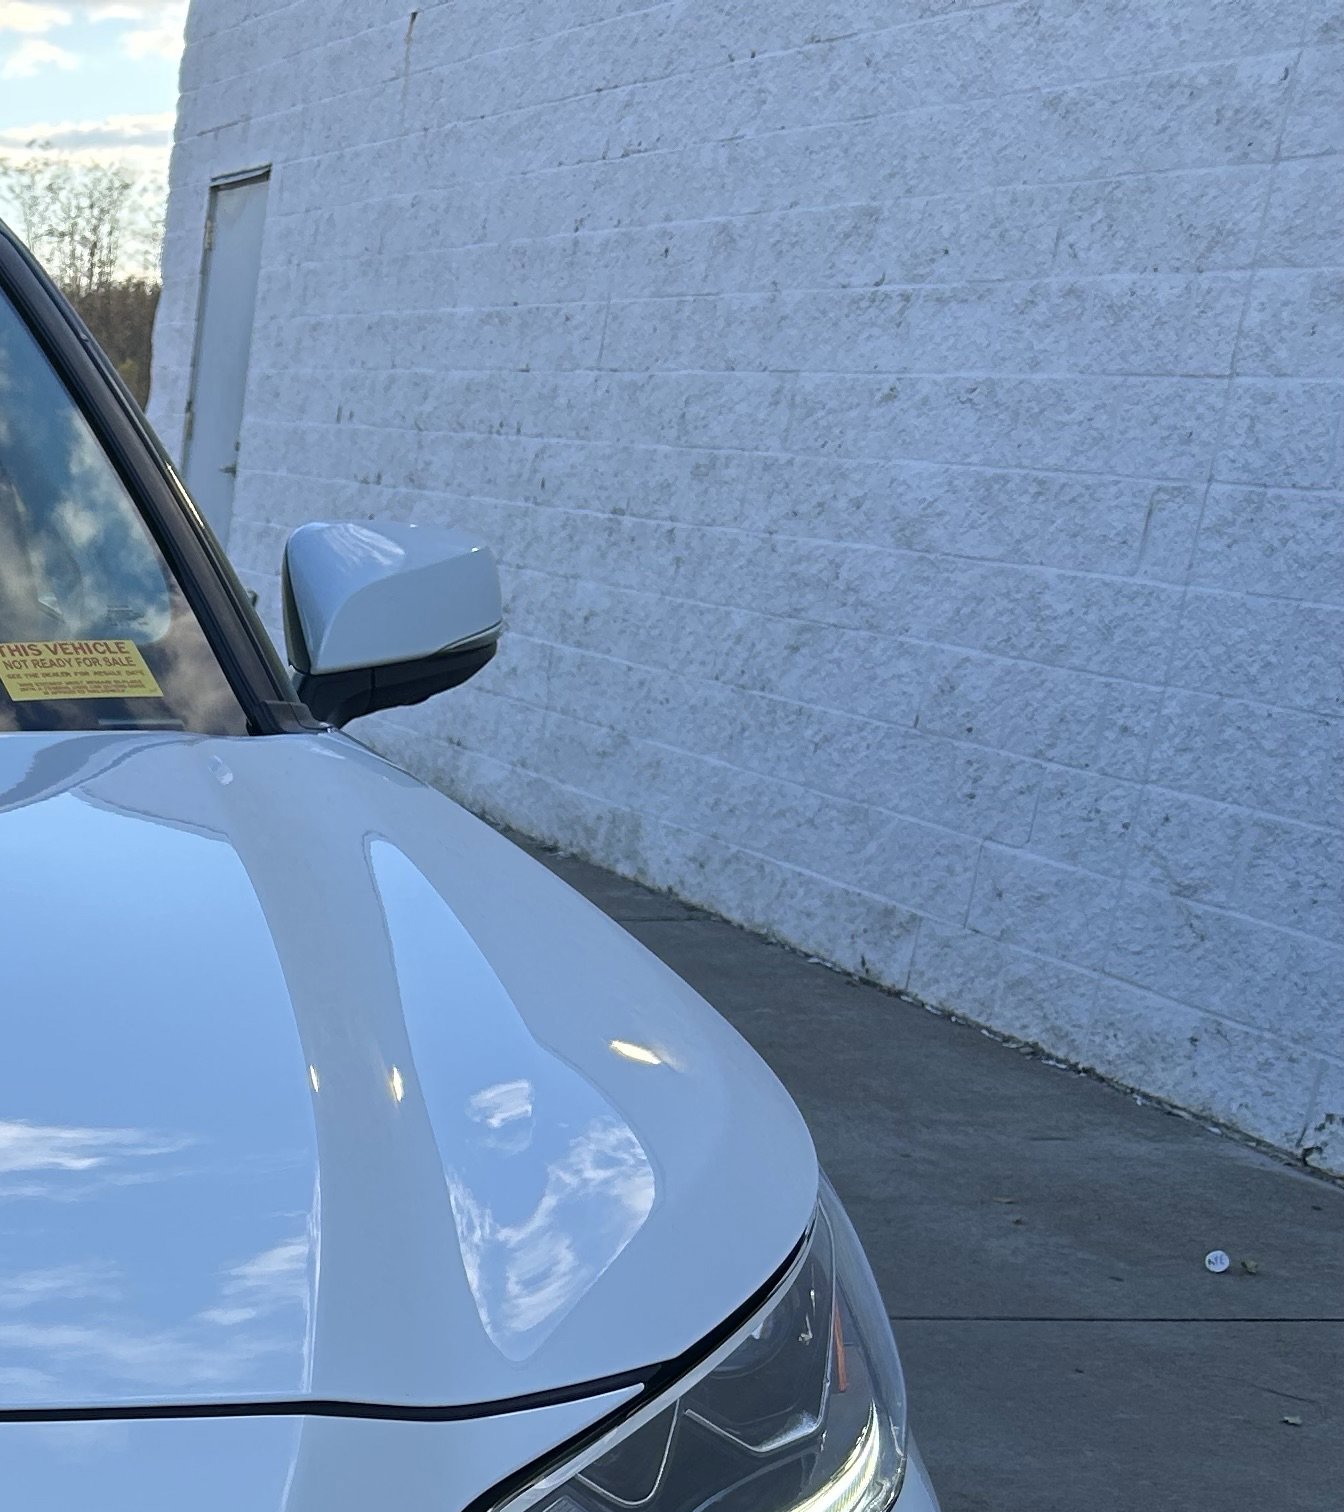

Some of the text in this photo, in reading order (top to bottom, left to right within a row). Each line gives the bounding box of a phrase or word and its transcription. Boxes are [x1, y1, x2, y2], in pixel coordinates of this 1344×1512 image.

[45, 642, 130, 656] VEHICLE
[3, 656, 136, 670] NOT READY FOR SALE
